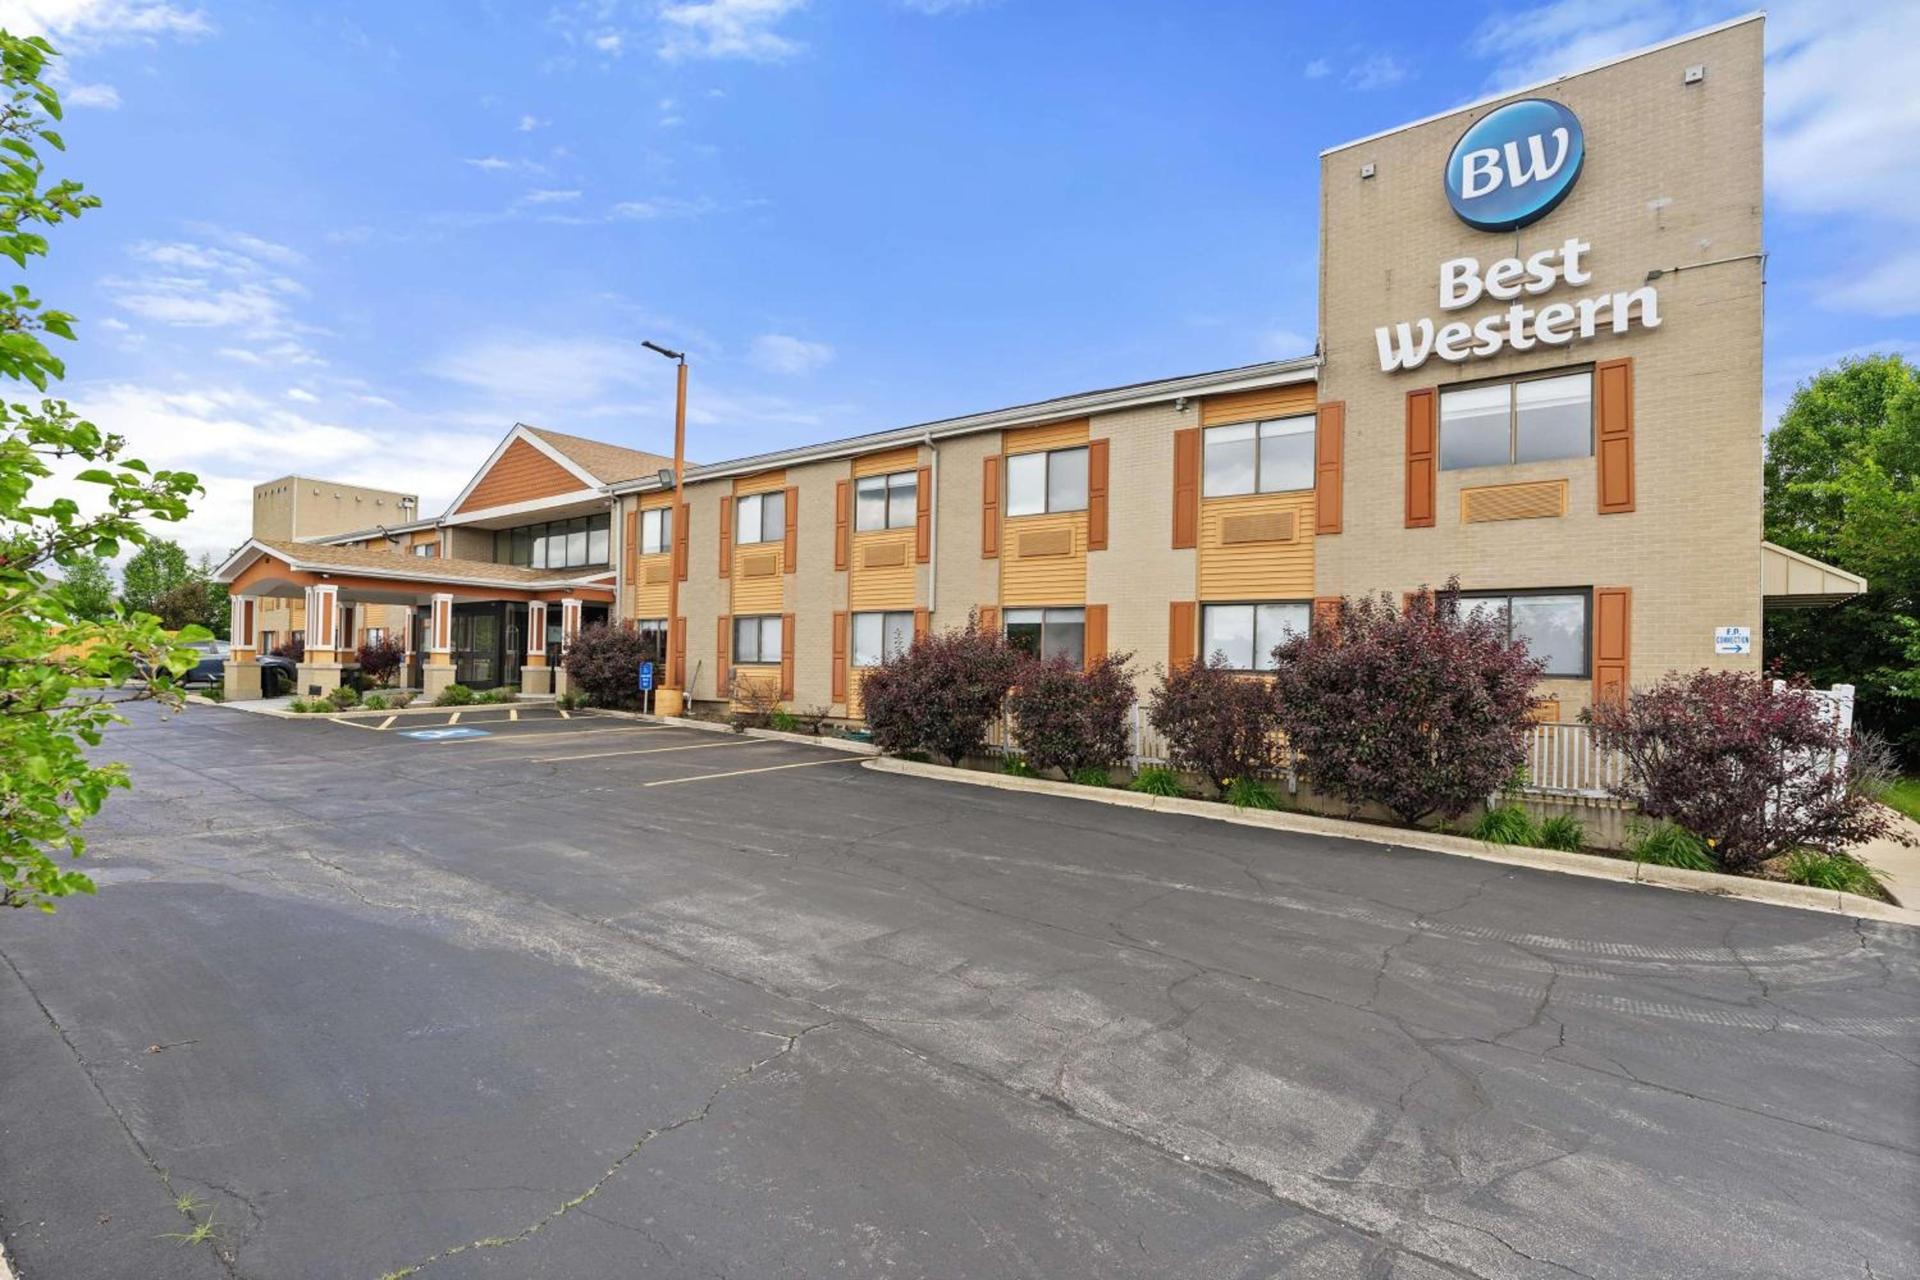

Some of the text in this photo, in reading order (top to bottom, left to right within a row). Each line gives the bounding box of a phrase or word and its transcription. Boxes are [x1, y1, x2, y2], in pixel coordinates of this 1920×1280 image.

[1461, 127, 1569, 200] BW
[1439, 237, 1592, 311] Best
[1374, 285, 1663, 373] Western
[1716, 636, 1749, 644] CONNECTION
